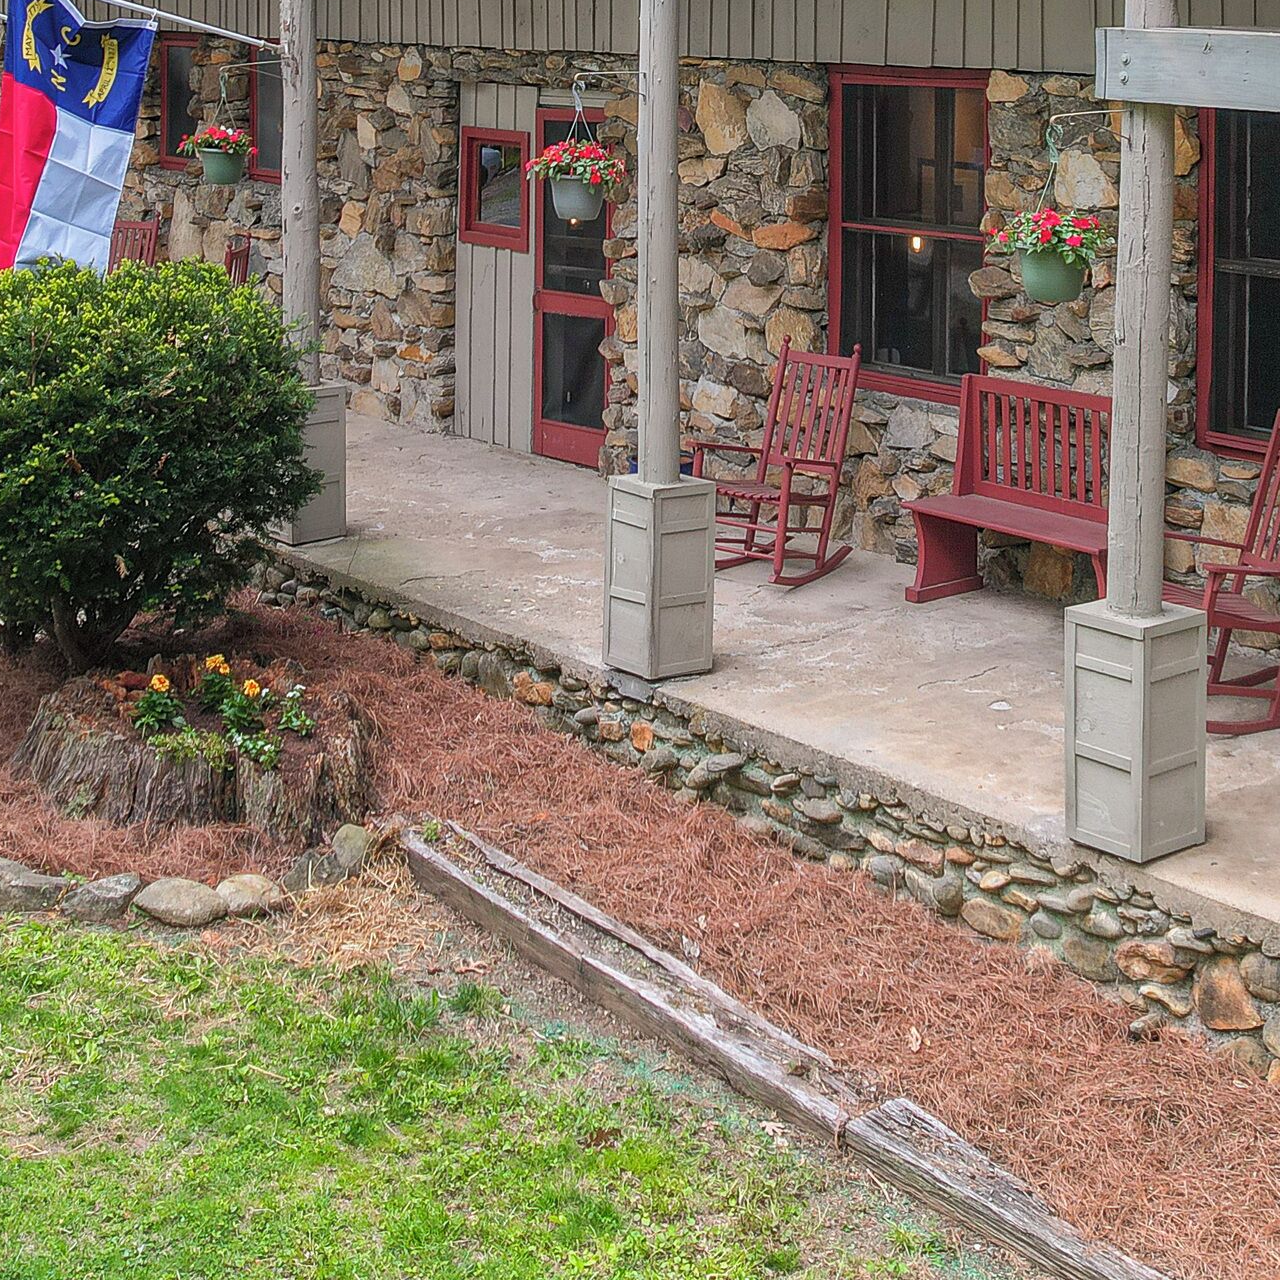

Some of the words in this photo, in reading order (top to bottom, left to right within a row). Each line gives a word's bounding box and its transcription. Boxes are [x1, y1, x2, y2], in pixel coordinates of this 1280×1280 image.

[51, 69, 66, 91] N
[60, 26, 81, 46] C
[97, 79, 111, 99] APRIL
